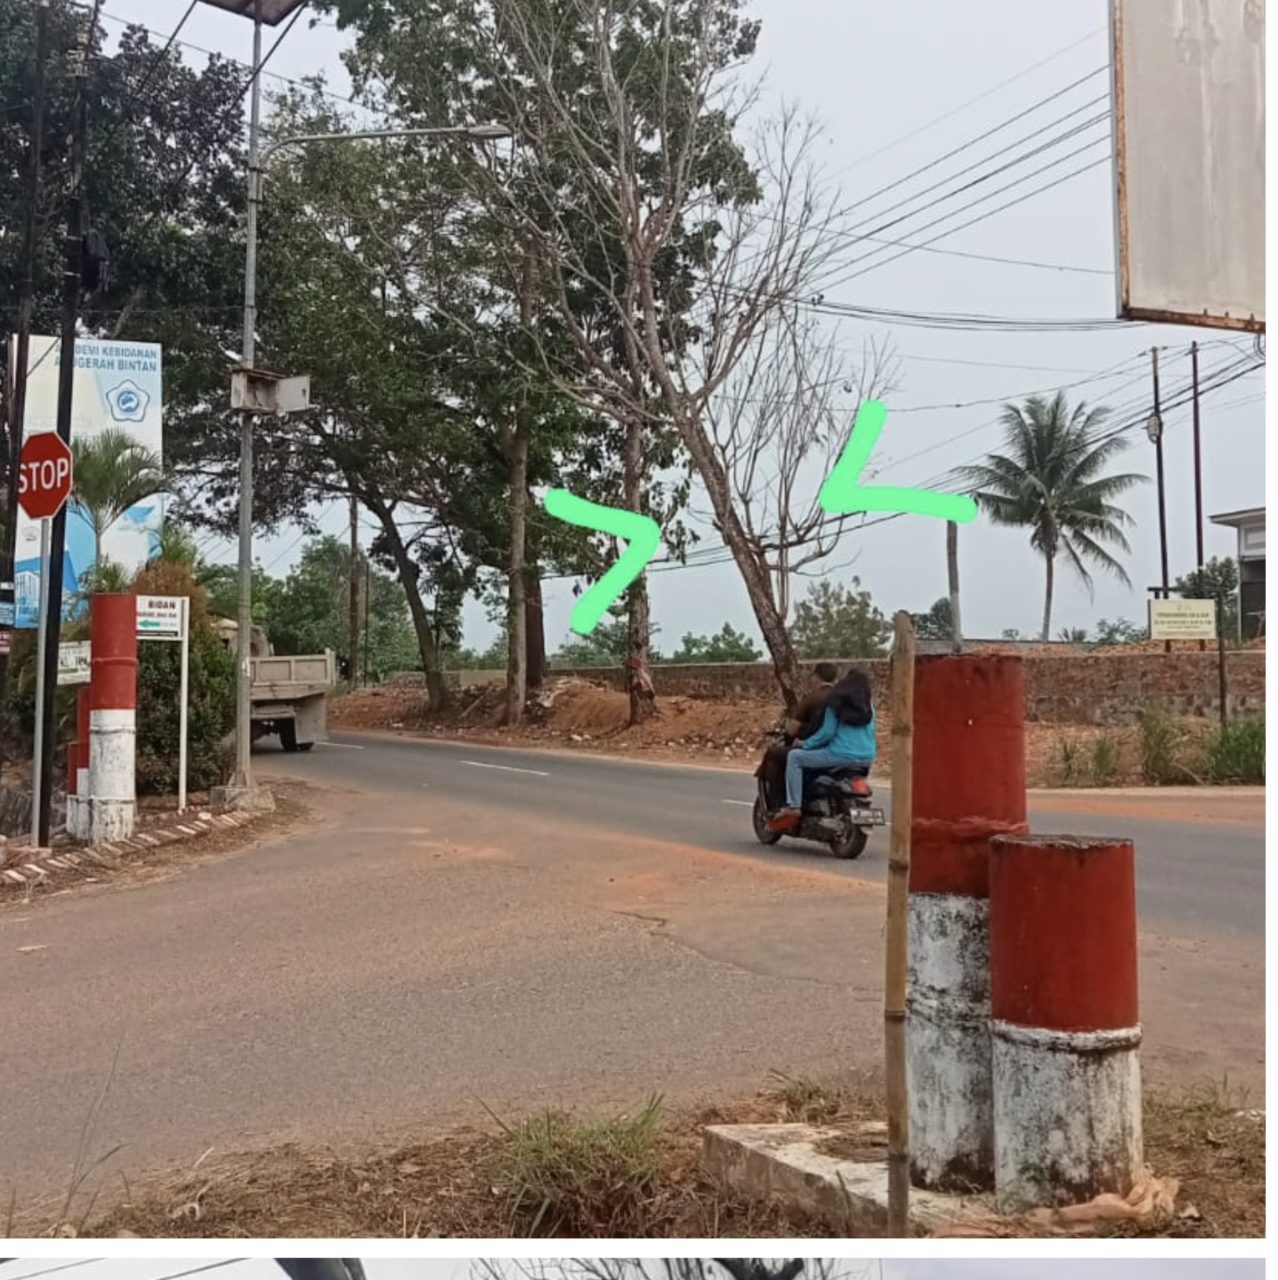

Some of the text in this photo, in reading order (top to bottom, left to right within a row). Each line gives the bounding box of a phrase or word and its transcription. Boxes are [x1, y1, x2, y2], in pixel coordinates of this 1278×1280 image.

[54, 344, 157, 358] ADEMI KEBIDANAN
[117, 360, 157, 371] BINTAN
[18, 457, 69, 494] STOP
